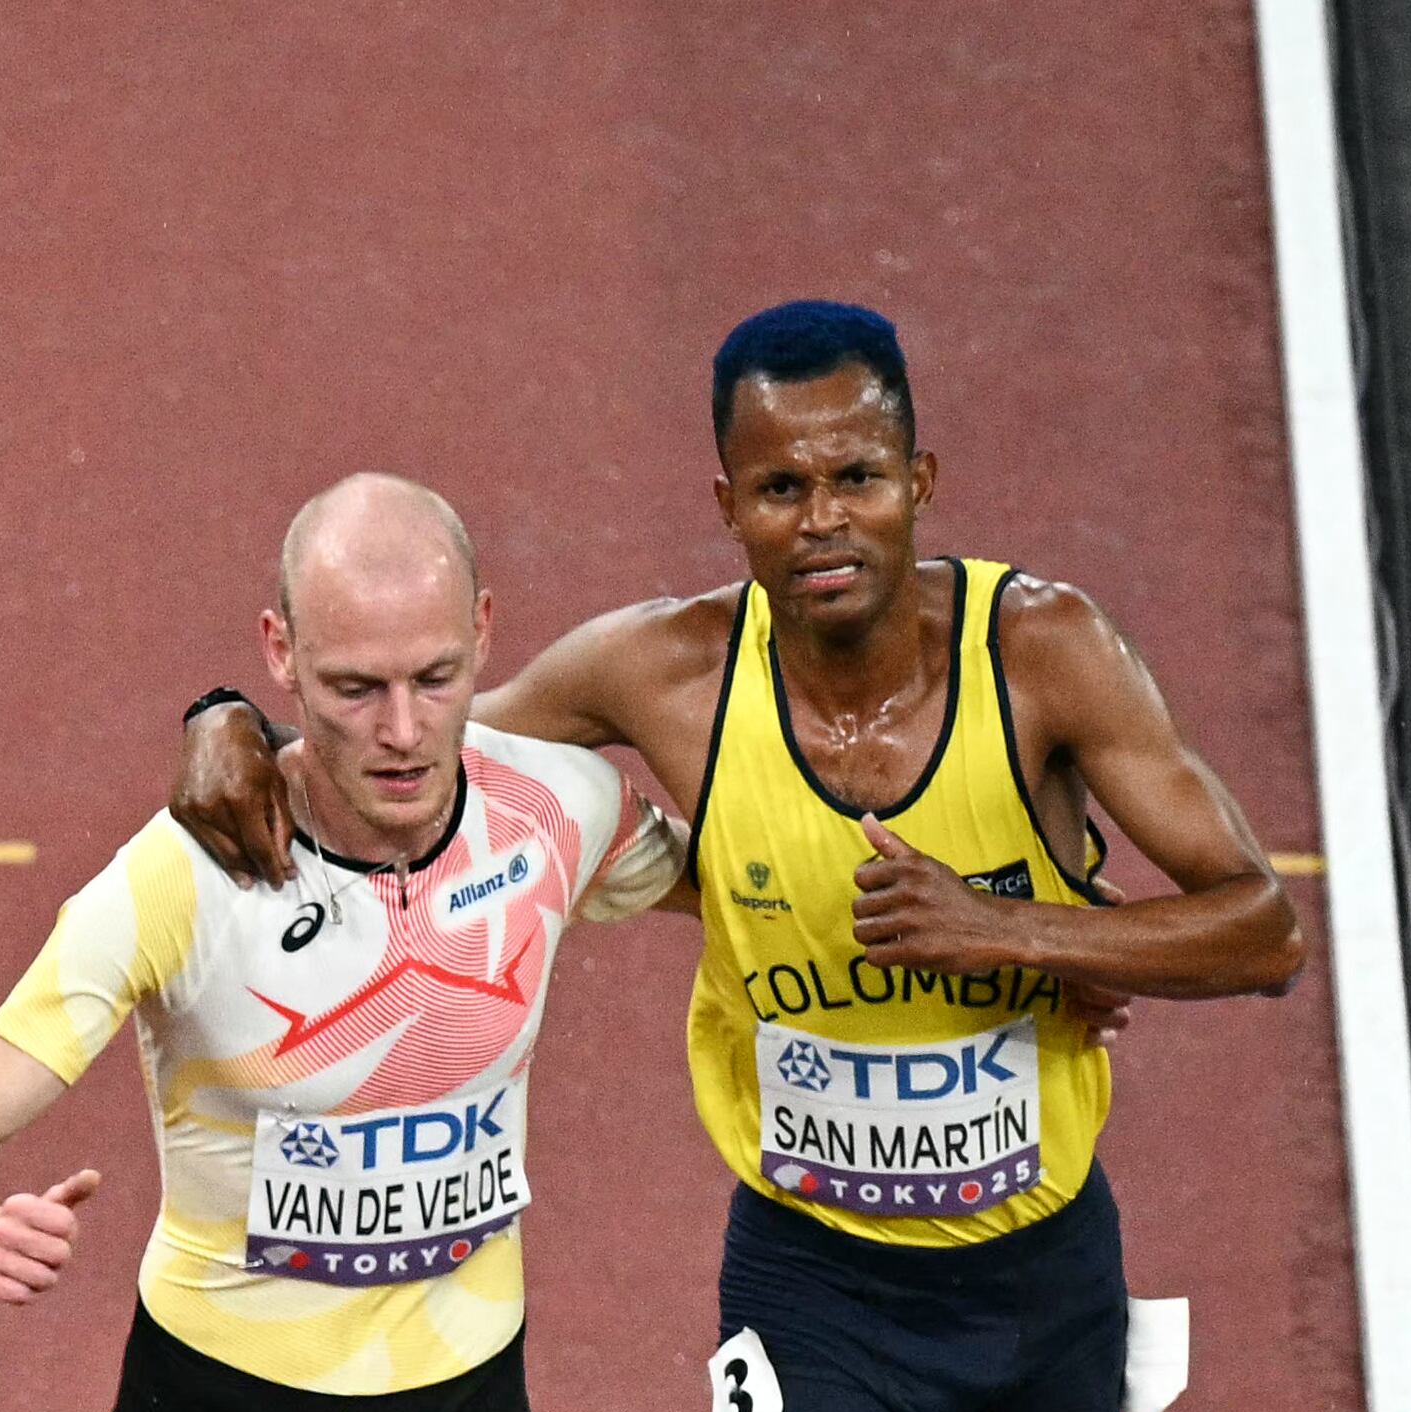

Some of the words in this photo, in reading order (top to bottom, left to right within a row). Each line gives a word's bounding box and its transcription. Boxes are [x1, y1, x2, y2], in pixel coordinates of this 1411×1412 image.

[449, 873, 505, 913] Allianz
[745, 955, 1061, 1023] COLOMBIA
[830, 1031, 1018, 1101] TDK
[341, 1087, 507, 1171] TDK
[774, 1105, 855, 1166] SAN
[869, 1096, 1027, 1169] MARTÍN
[265, 1179, 344, 1236] VAN
[356, 1183, 404, 1236] DE
[416, 1148, 519, 1230] VELDE
